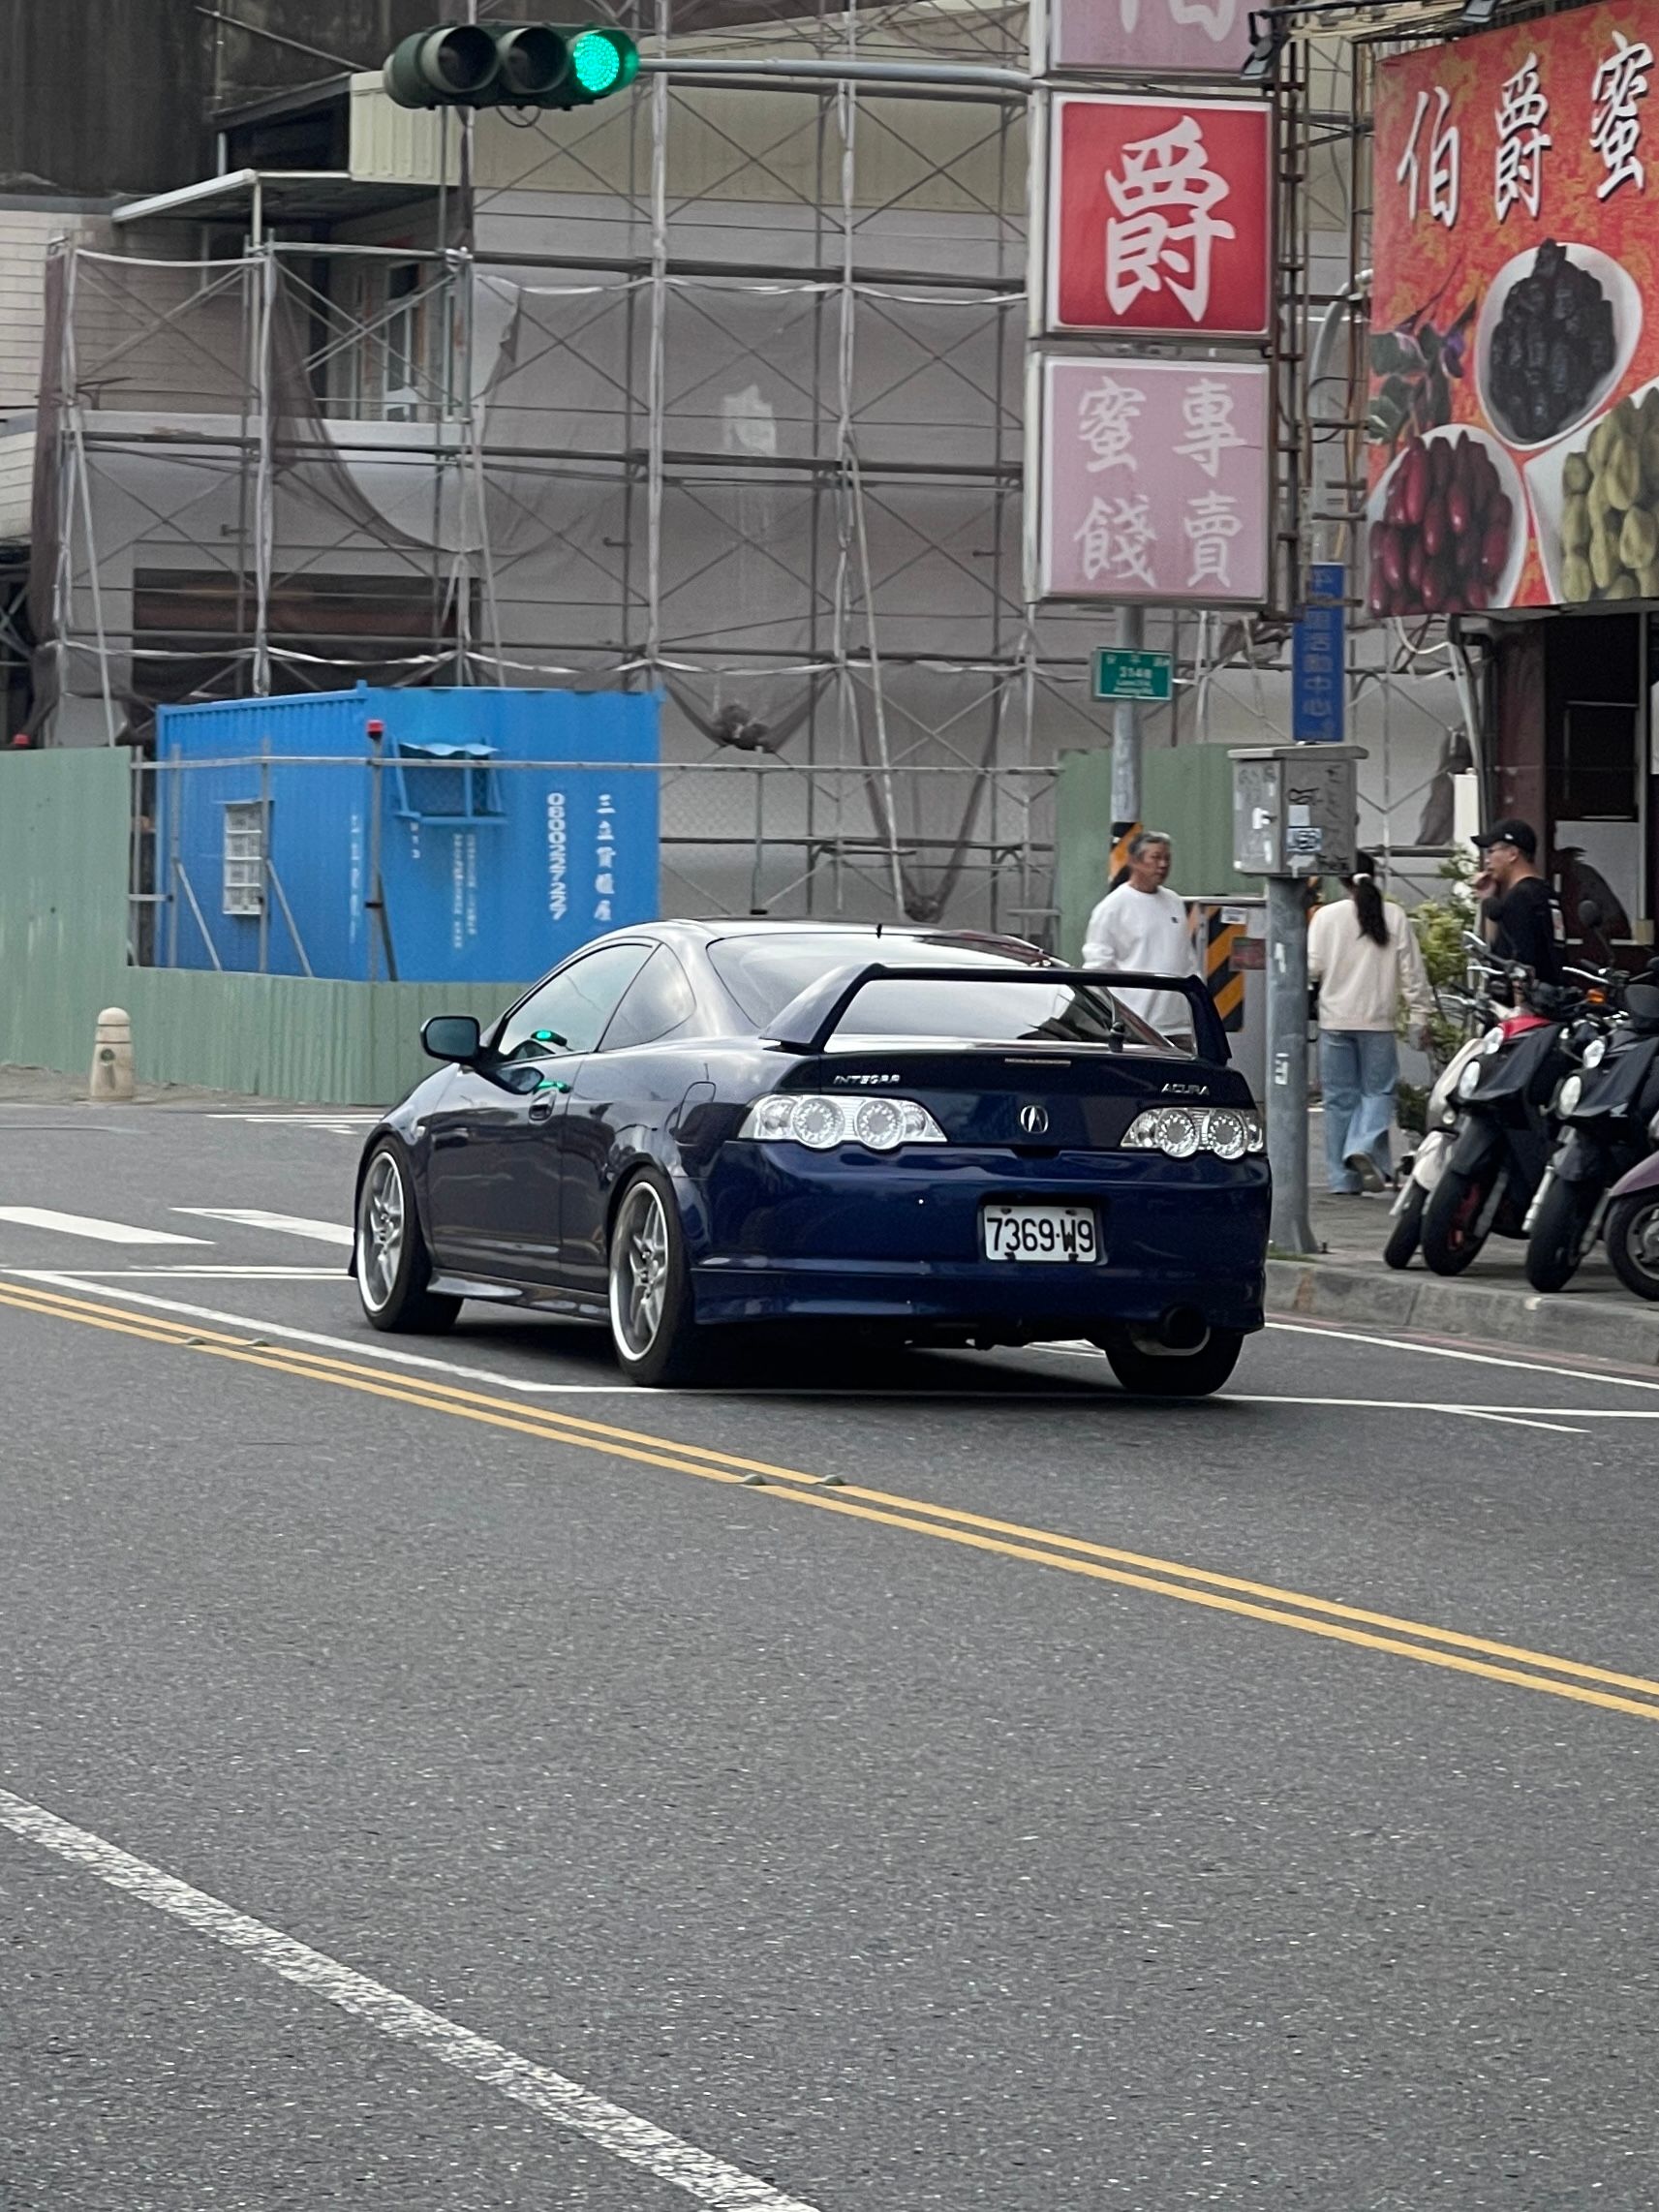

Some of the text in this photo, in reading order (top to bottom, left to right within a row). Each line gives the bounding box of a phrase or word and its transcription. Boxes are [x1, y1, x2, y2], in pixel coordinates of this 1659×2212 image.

[1104, 114, 1236, 323] 爵
[1397, 29, 1653, 228] 伯爵蜜
[1172, 378, 1248, 589] 專賣
[833, 1074, 901, 1085] INTEGRA
[1161, 1083, 1210, 1095] ACURA
